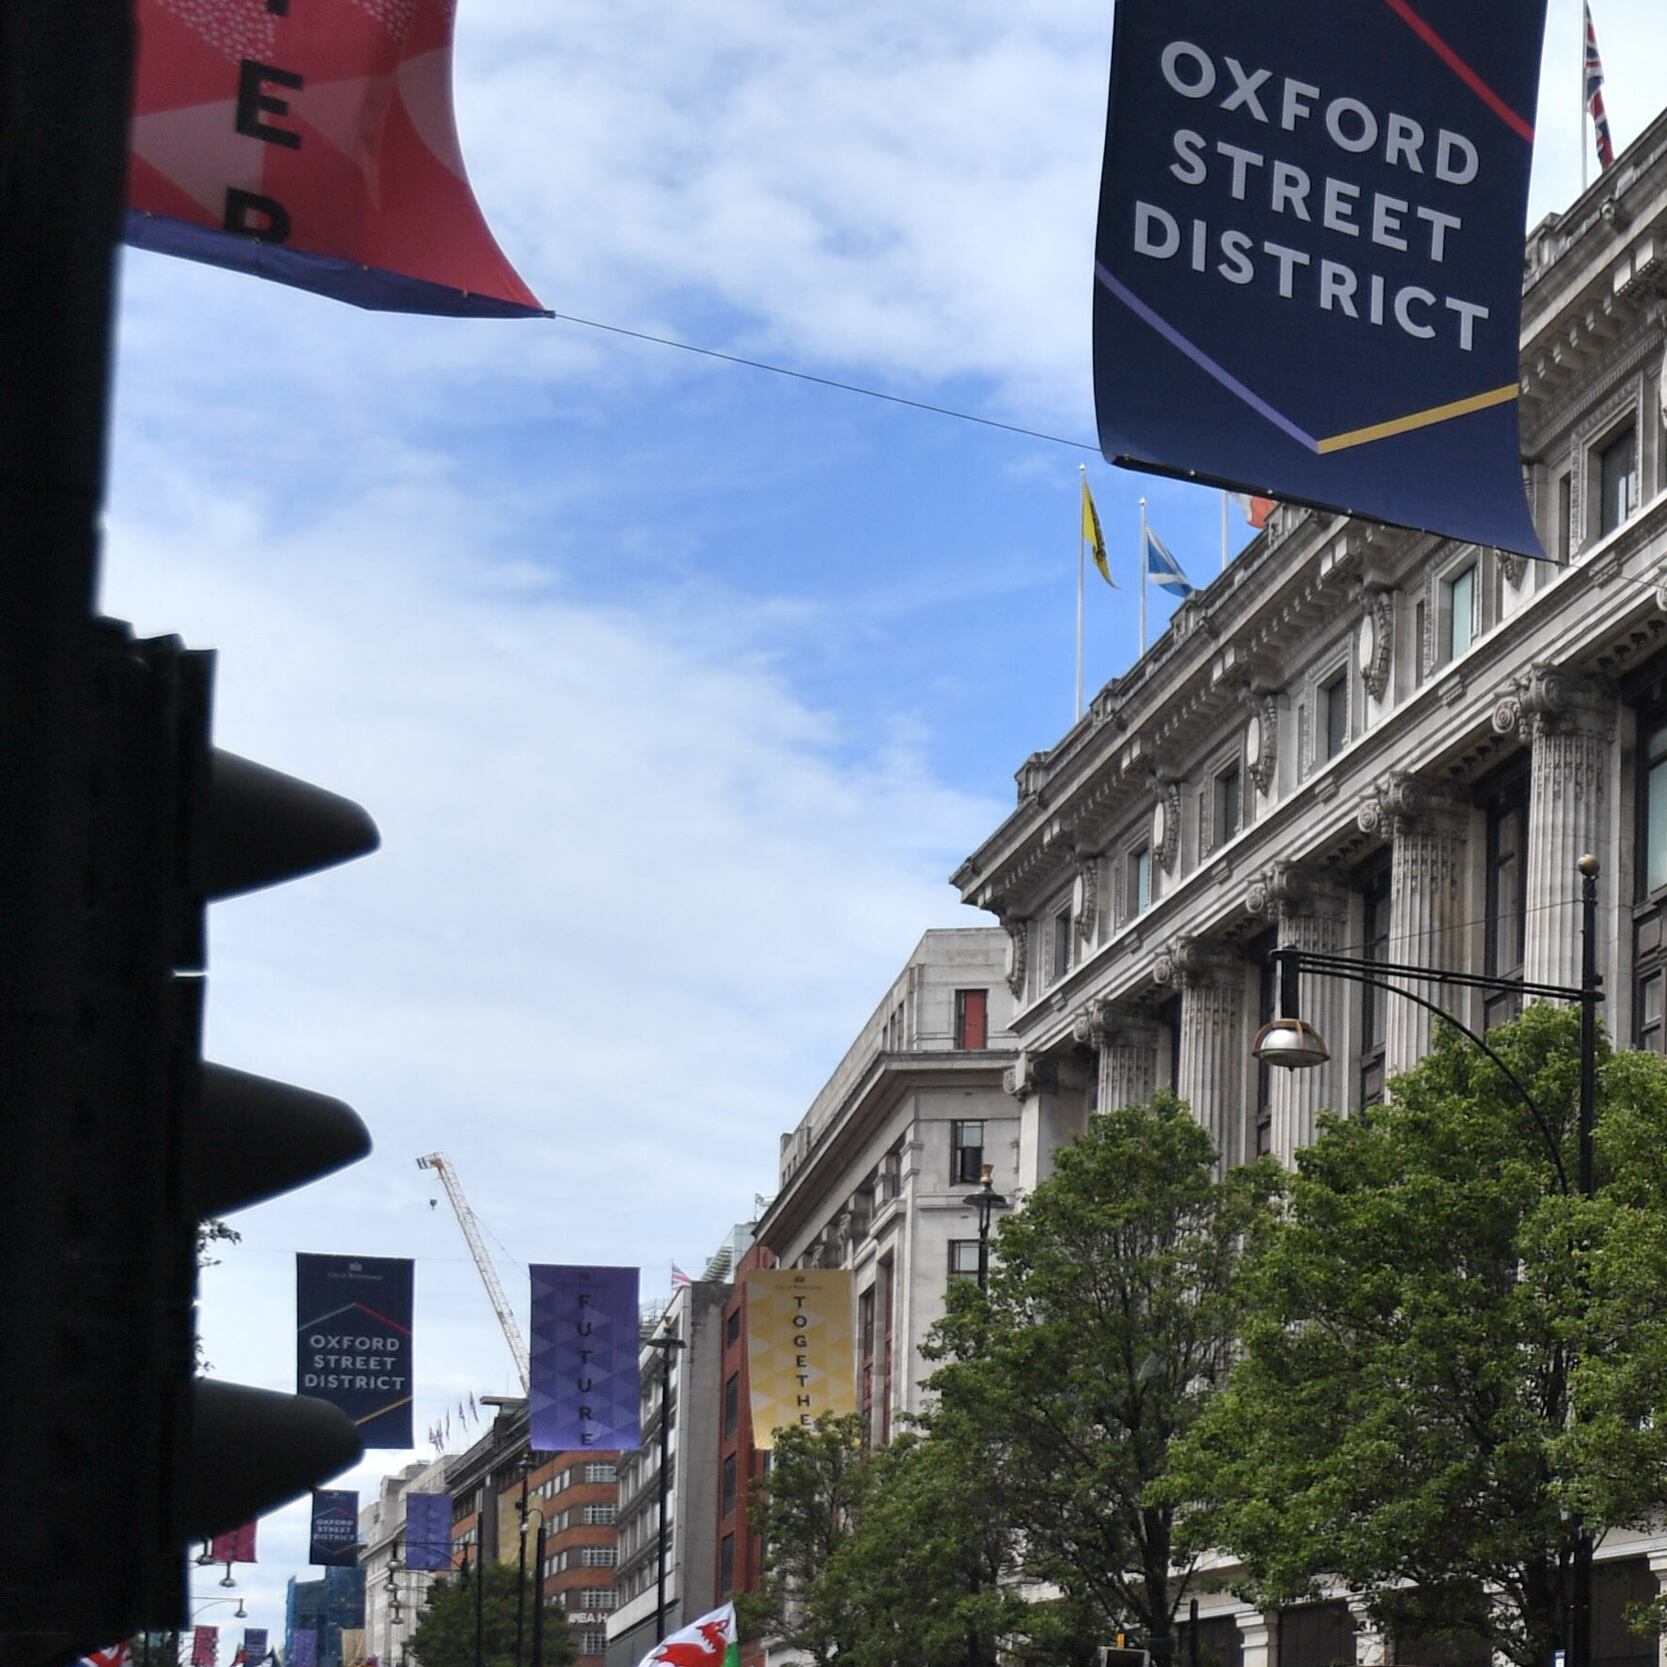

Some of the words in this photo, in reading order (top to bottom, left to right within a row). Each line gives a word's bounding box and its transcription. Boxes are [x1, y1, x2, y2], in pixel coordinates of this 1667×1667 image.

[1161, 41, 1479, 185] OXFORD
[1169, 129, 1461, 263] STREET
[1134, 199, 1490, 351] DISTRICT
[304, 1374, 406, 1391] DISTRICT
[309, 1334, 400, 1352] OXFORD
[313, 1355, 397, 1371] STREET
[576, 1294, 594, 1447] FUTURE
[792, 1295, 811, 1427] TOGETHE
